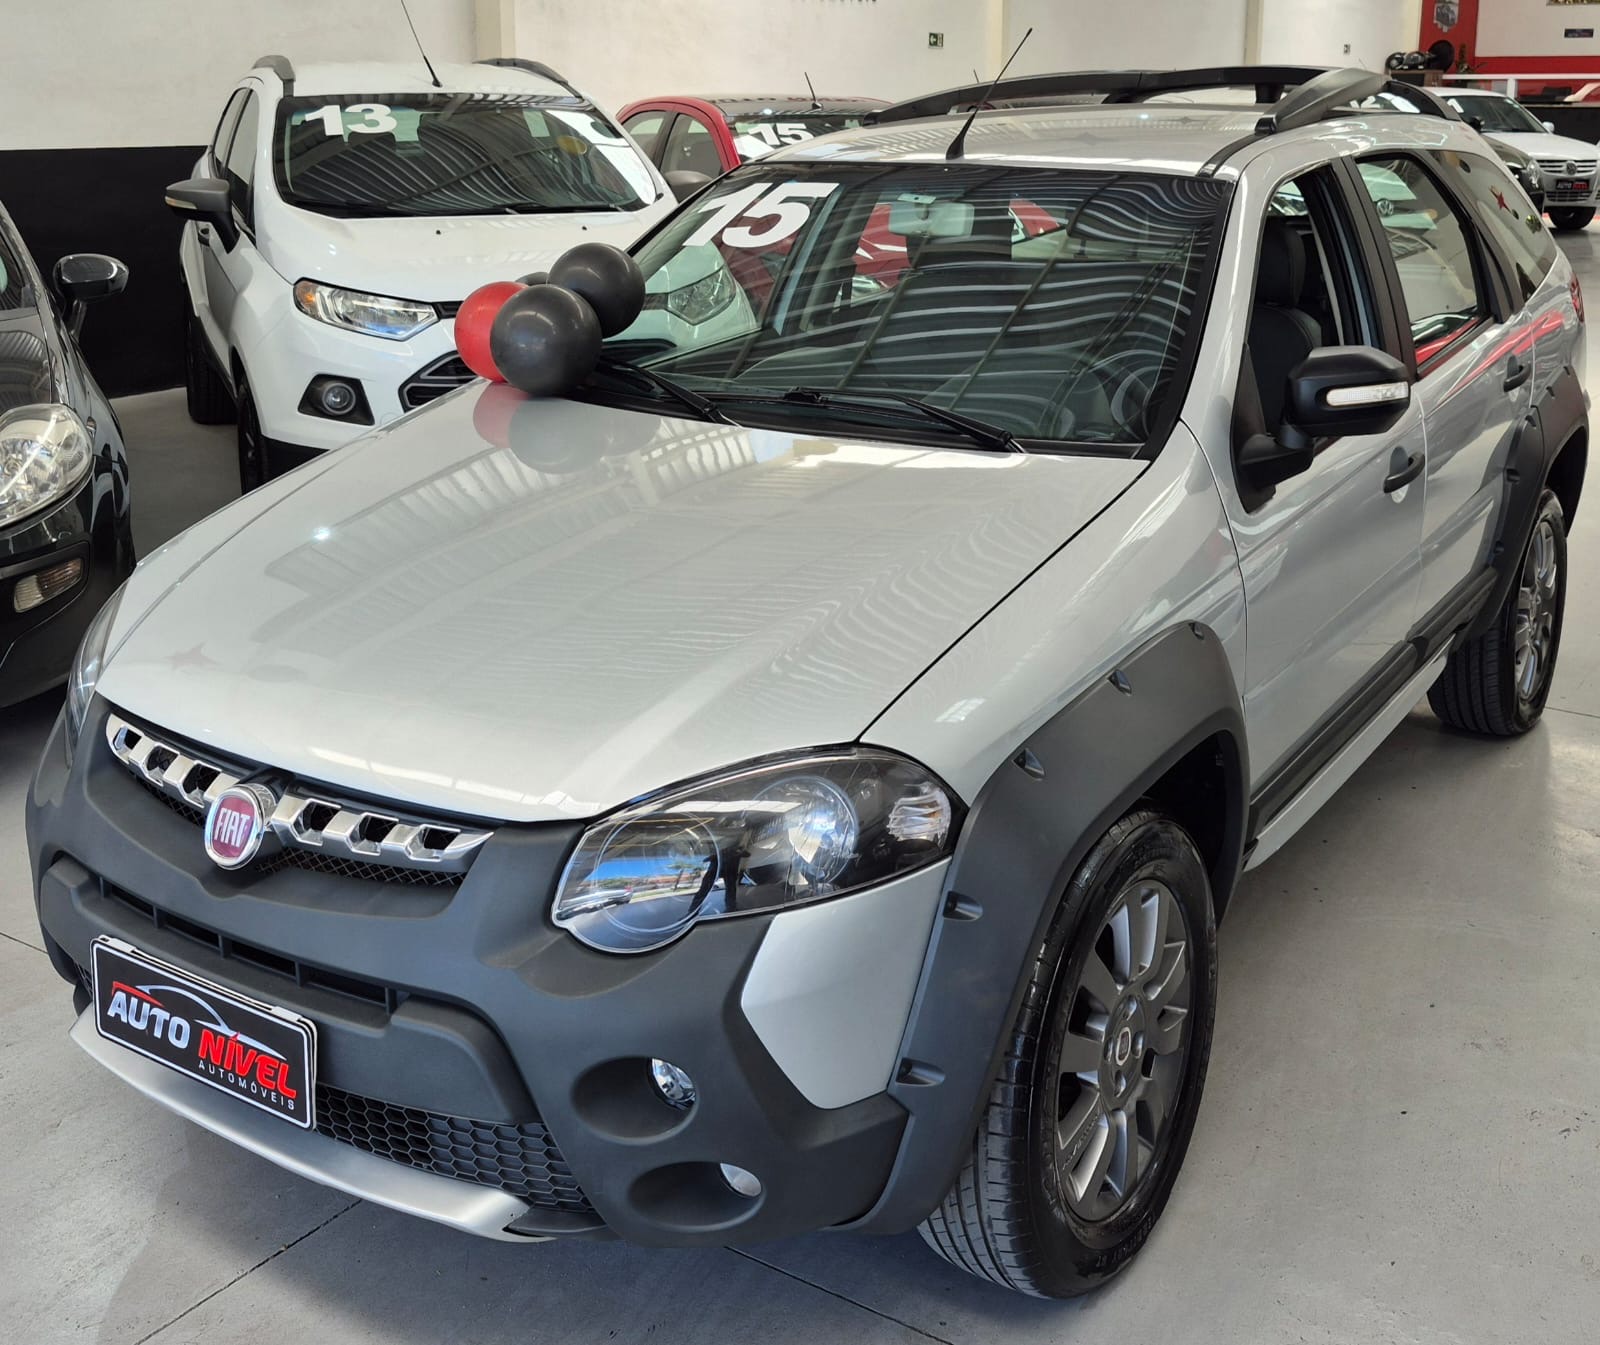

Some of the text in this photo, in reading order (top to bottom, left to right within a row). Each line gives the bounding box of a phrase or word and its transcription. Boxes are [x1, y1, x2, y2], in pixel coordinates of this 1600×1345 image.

[304, 103, 398, 136] 13
[748, 122, 814, 146] 15
[682, 182, 840, 248] 15
[213, 807, 251, 848] FIAT
[107, 990, 297, 1099] AUTO NÍVEL
[198, 1059, 296, 1111] AUTOMÓVEIS
